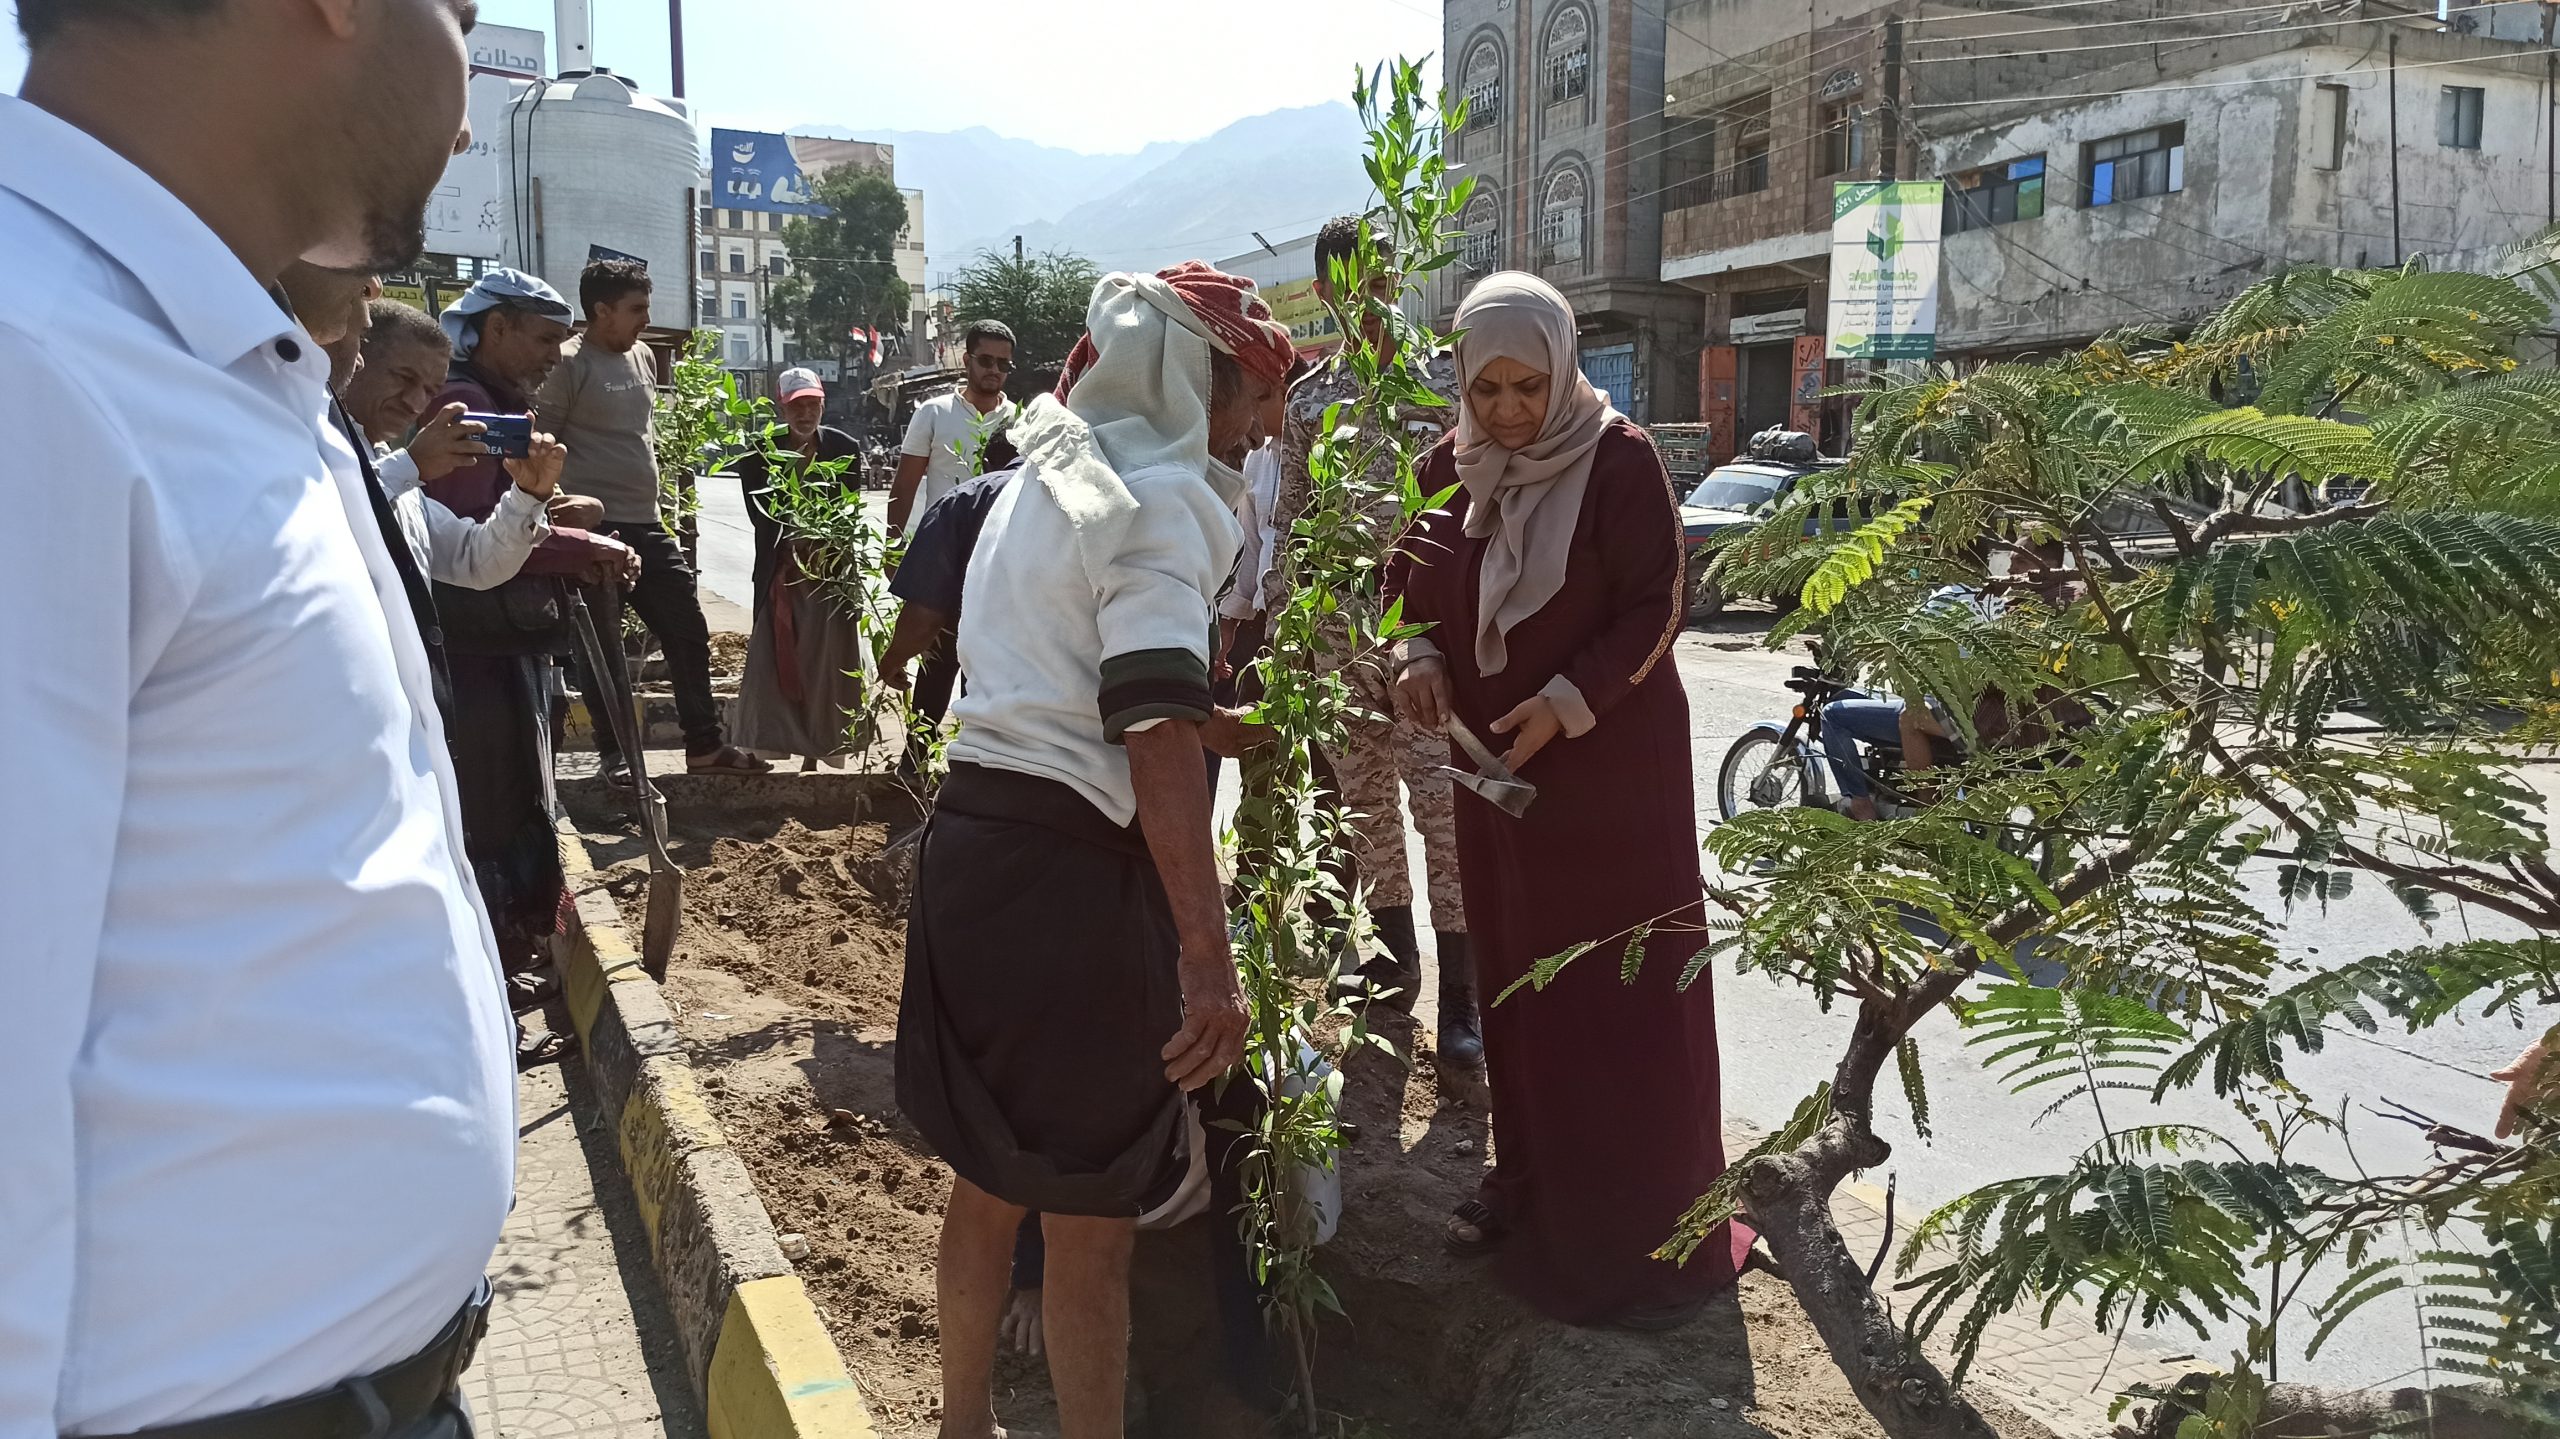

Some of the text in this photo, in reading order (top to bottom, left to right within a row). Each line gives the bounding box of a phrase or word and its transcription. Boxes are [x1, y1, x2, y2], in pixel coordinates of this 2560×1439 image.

[473, 47, 538, 71] محلات
[1849, 268, 1918, 283] جامعة الرواد
[1882, 284, 1917, 292] University
